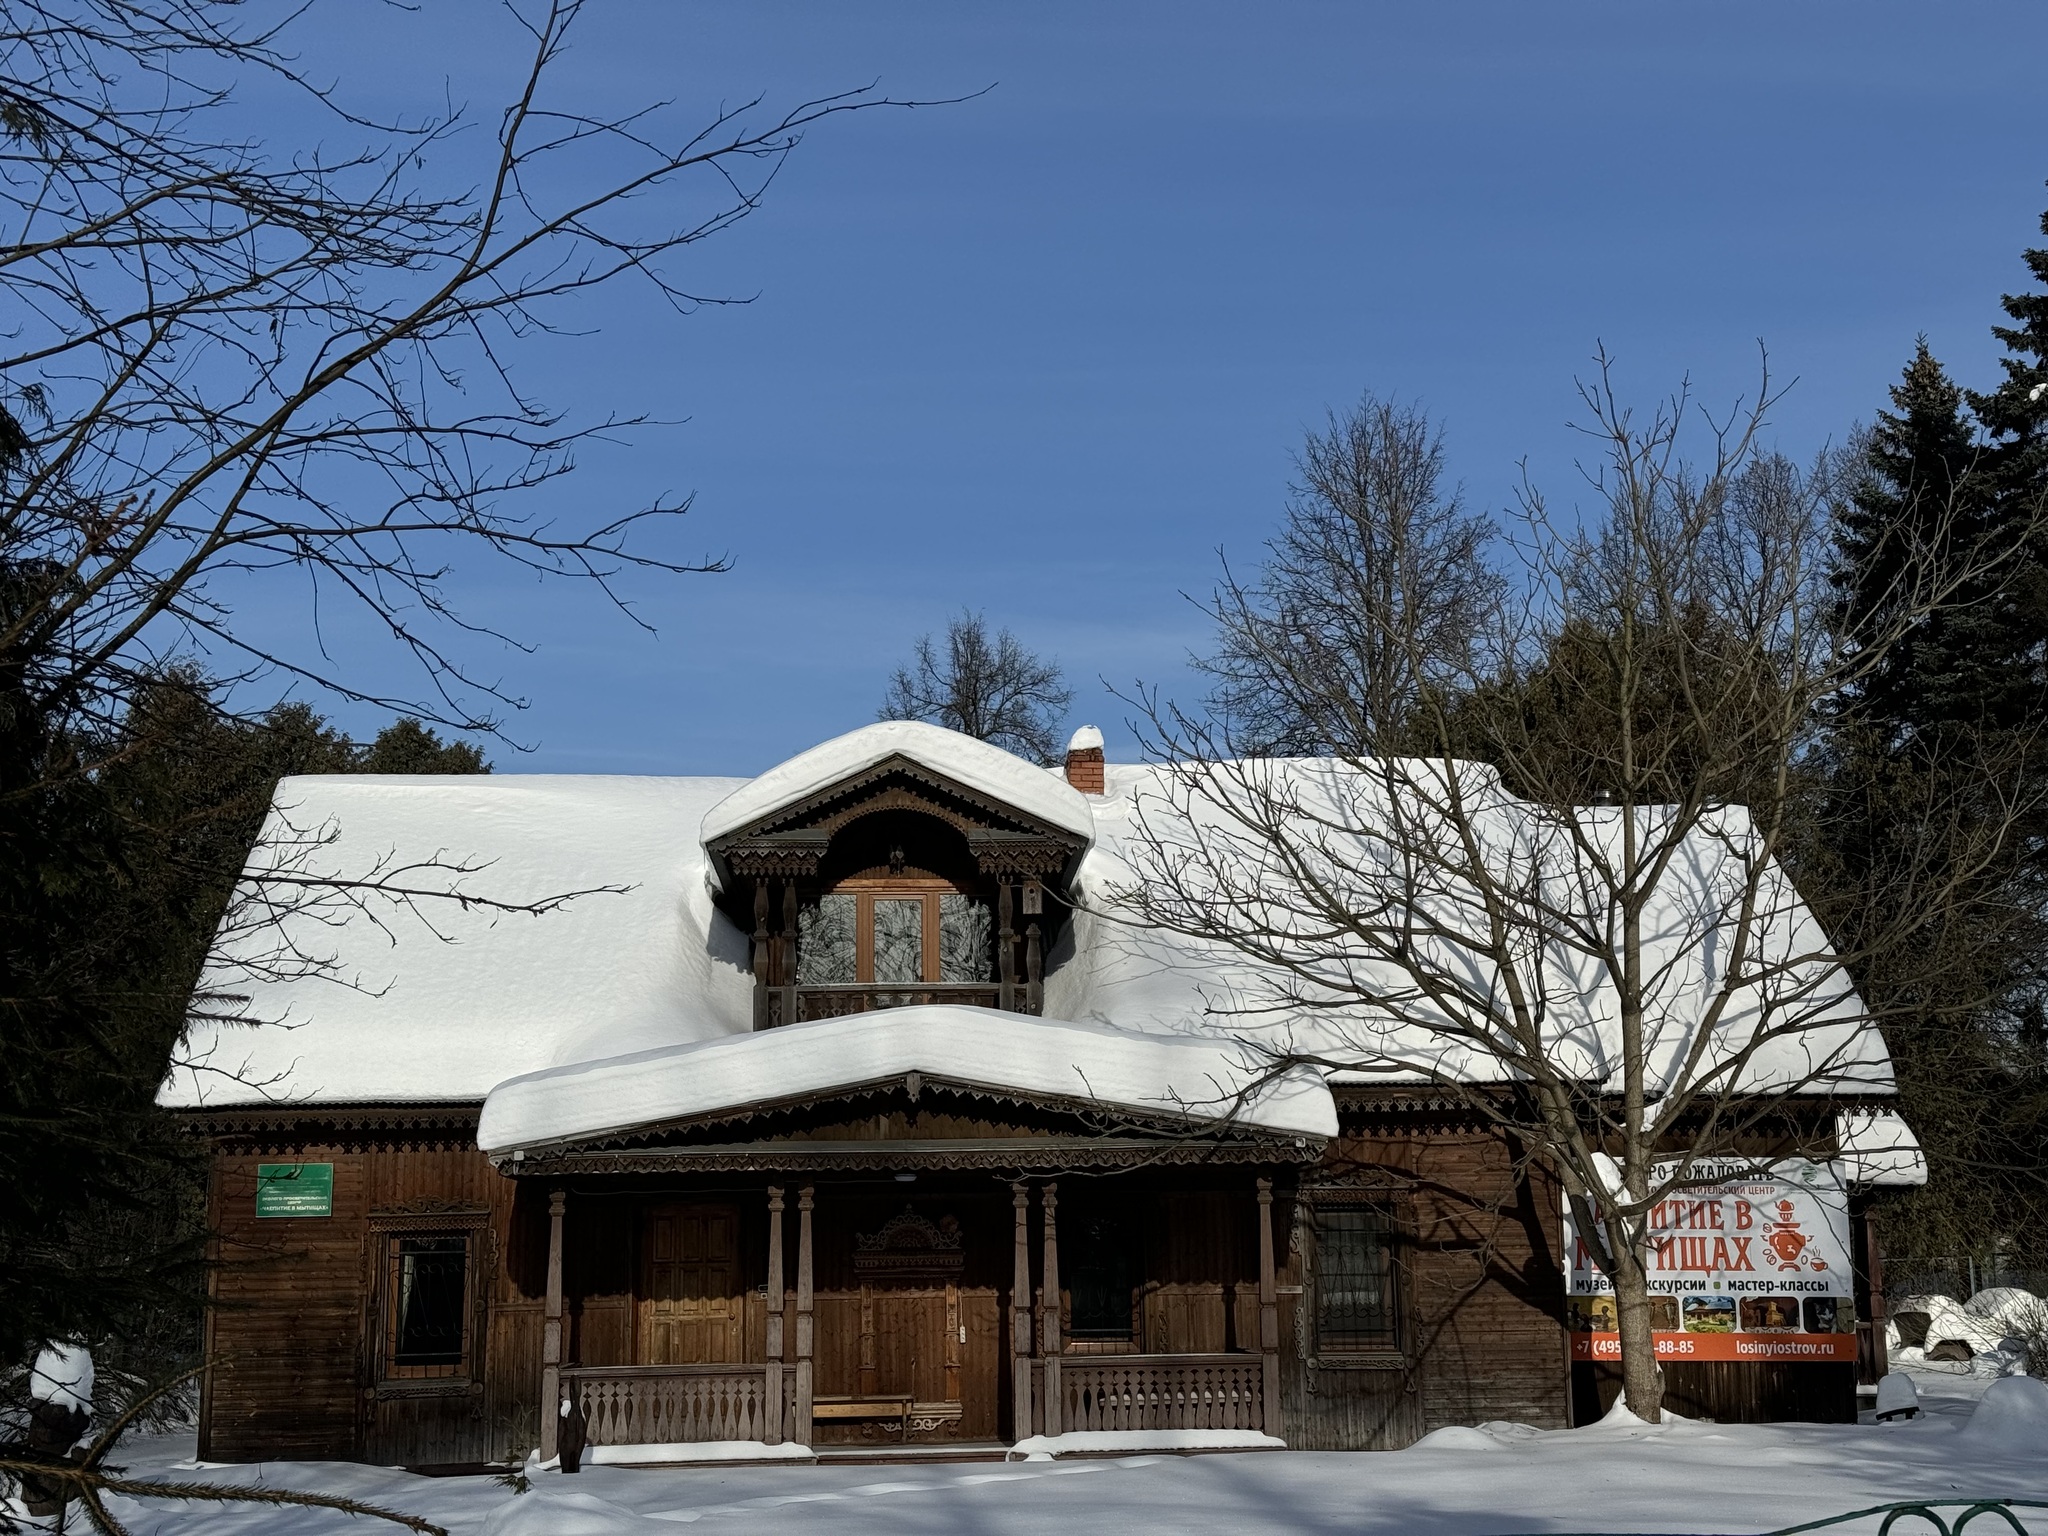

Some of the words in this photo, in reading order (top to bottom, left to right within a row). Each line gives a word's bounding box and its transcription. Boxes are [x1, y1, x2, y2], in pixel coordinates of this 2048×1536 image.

[1748, 1186, 1776, 1196] ЦЕНТР
[1735, 1200, 1754, 1231] В
[1574, 1236, 1756, 1278] МИЩАХ
[1646, 1278, 1707, 1294] кскурсии
[1728, 1278, 1829, 1294] мастер-классы
[1576, 1341, 1590, 1354] +7
[1736, 1340, 1835, 1357] losinyiostrov.ru
